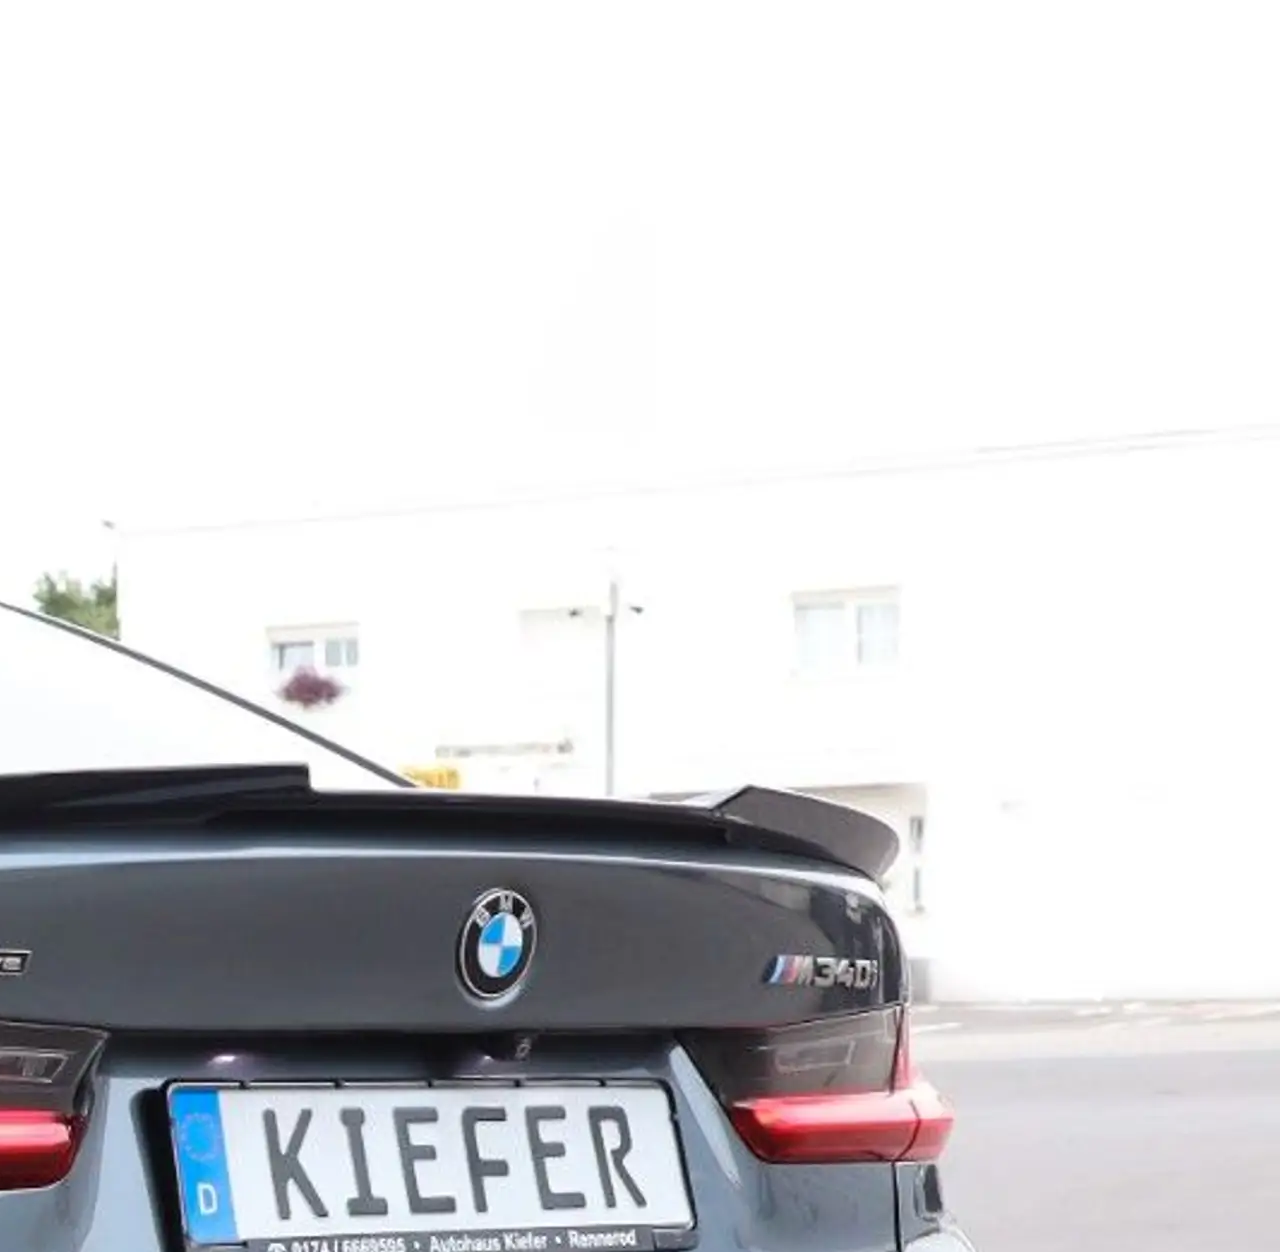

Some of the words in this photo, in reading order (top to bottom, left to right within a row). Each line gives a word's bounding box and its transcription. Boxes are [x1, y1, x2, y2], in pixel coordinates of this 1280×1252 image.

[475, 892, 535, 928] BMW
[262, 1105, 647, 1220] KIEFER
[196, 1181, 219, 1217] D
